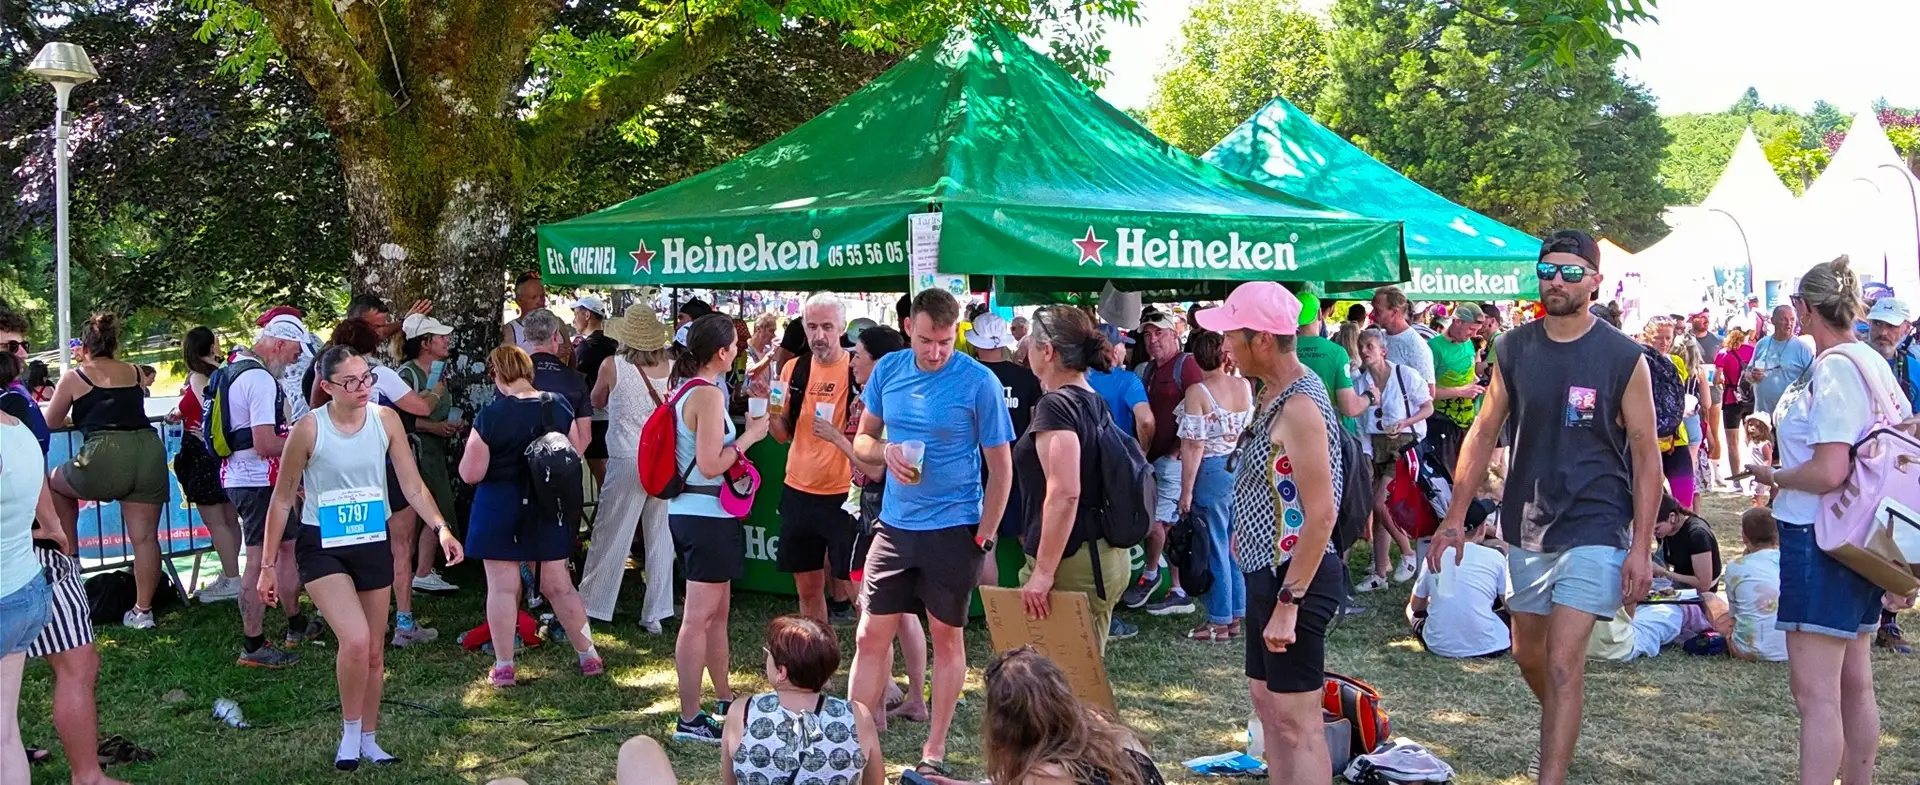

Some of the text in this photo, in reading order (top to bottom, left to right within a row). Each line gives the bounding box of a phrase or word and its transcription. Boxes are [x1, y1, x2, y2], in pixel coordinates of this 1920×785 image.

[570, 246, 616, 275] CHENEL
[661, 233, 820, 274] Heineken
[828, 245, 844, 267] 05
[846, 244, 863, 266] 55
[864, 242, 883, 264] 56
[885, 241, 904, 263] 05
[1115, 227, 1298, 271] Heineken
[1403, 267, 1520, 295] Heineken
[337, 503, 369, 524] 5797
[743, 525, 780, 562] He
